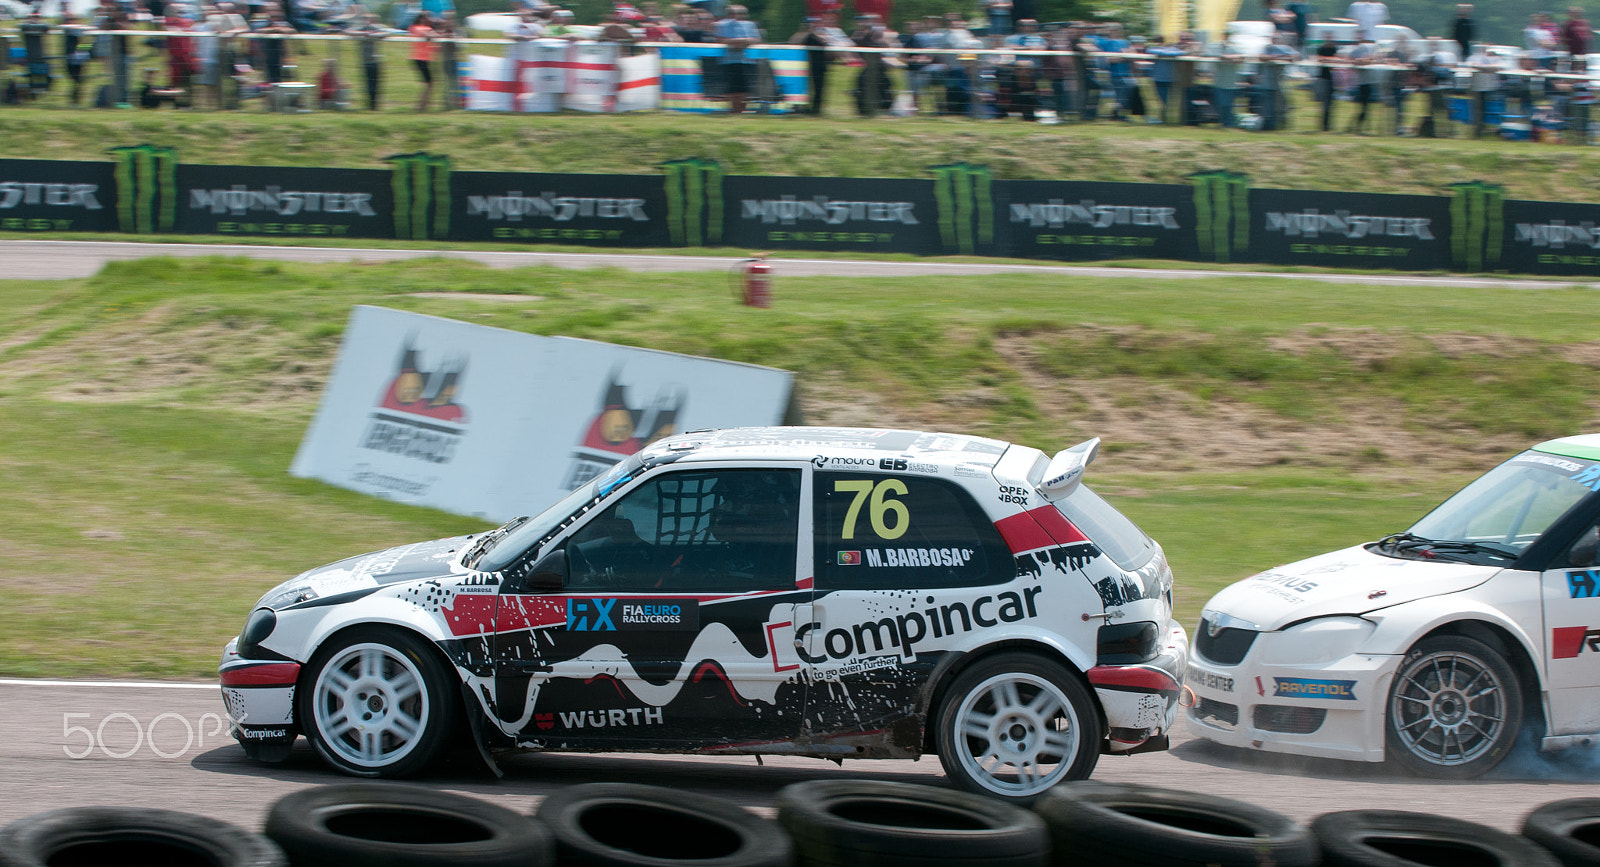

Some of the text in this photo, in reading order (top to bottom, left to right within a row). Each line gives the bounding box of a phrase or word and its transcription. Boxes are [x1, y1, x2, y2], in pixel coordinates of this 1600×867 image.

[831, 457, 875, 466] moura
[834, 479, 909, 540] 76
[865, 547, 964, 568] M.BARBOSA
[795, 585, 1042, 664] Compincar
[814, 657, 896, 680] to go even further
[1280, 682, 1350, 696] RAVENOL
[559, 707, 663, 729] WÜRTH
[243, 728, 286, 740] Compincar
